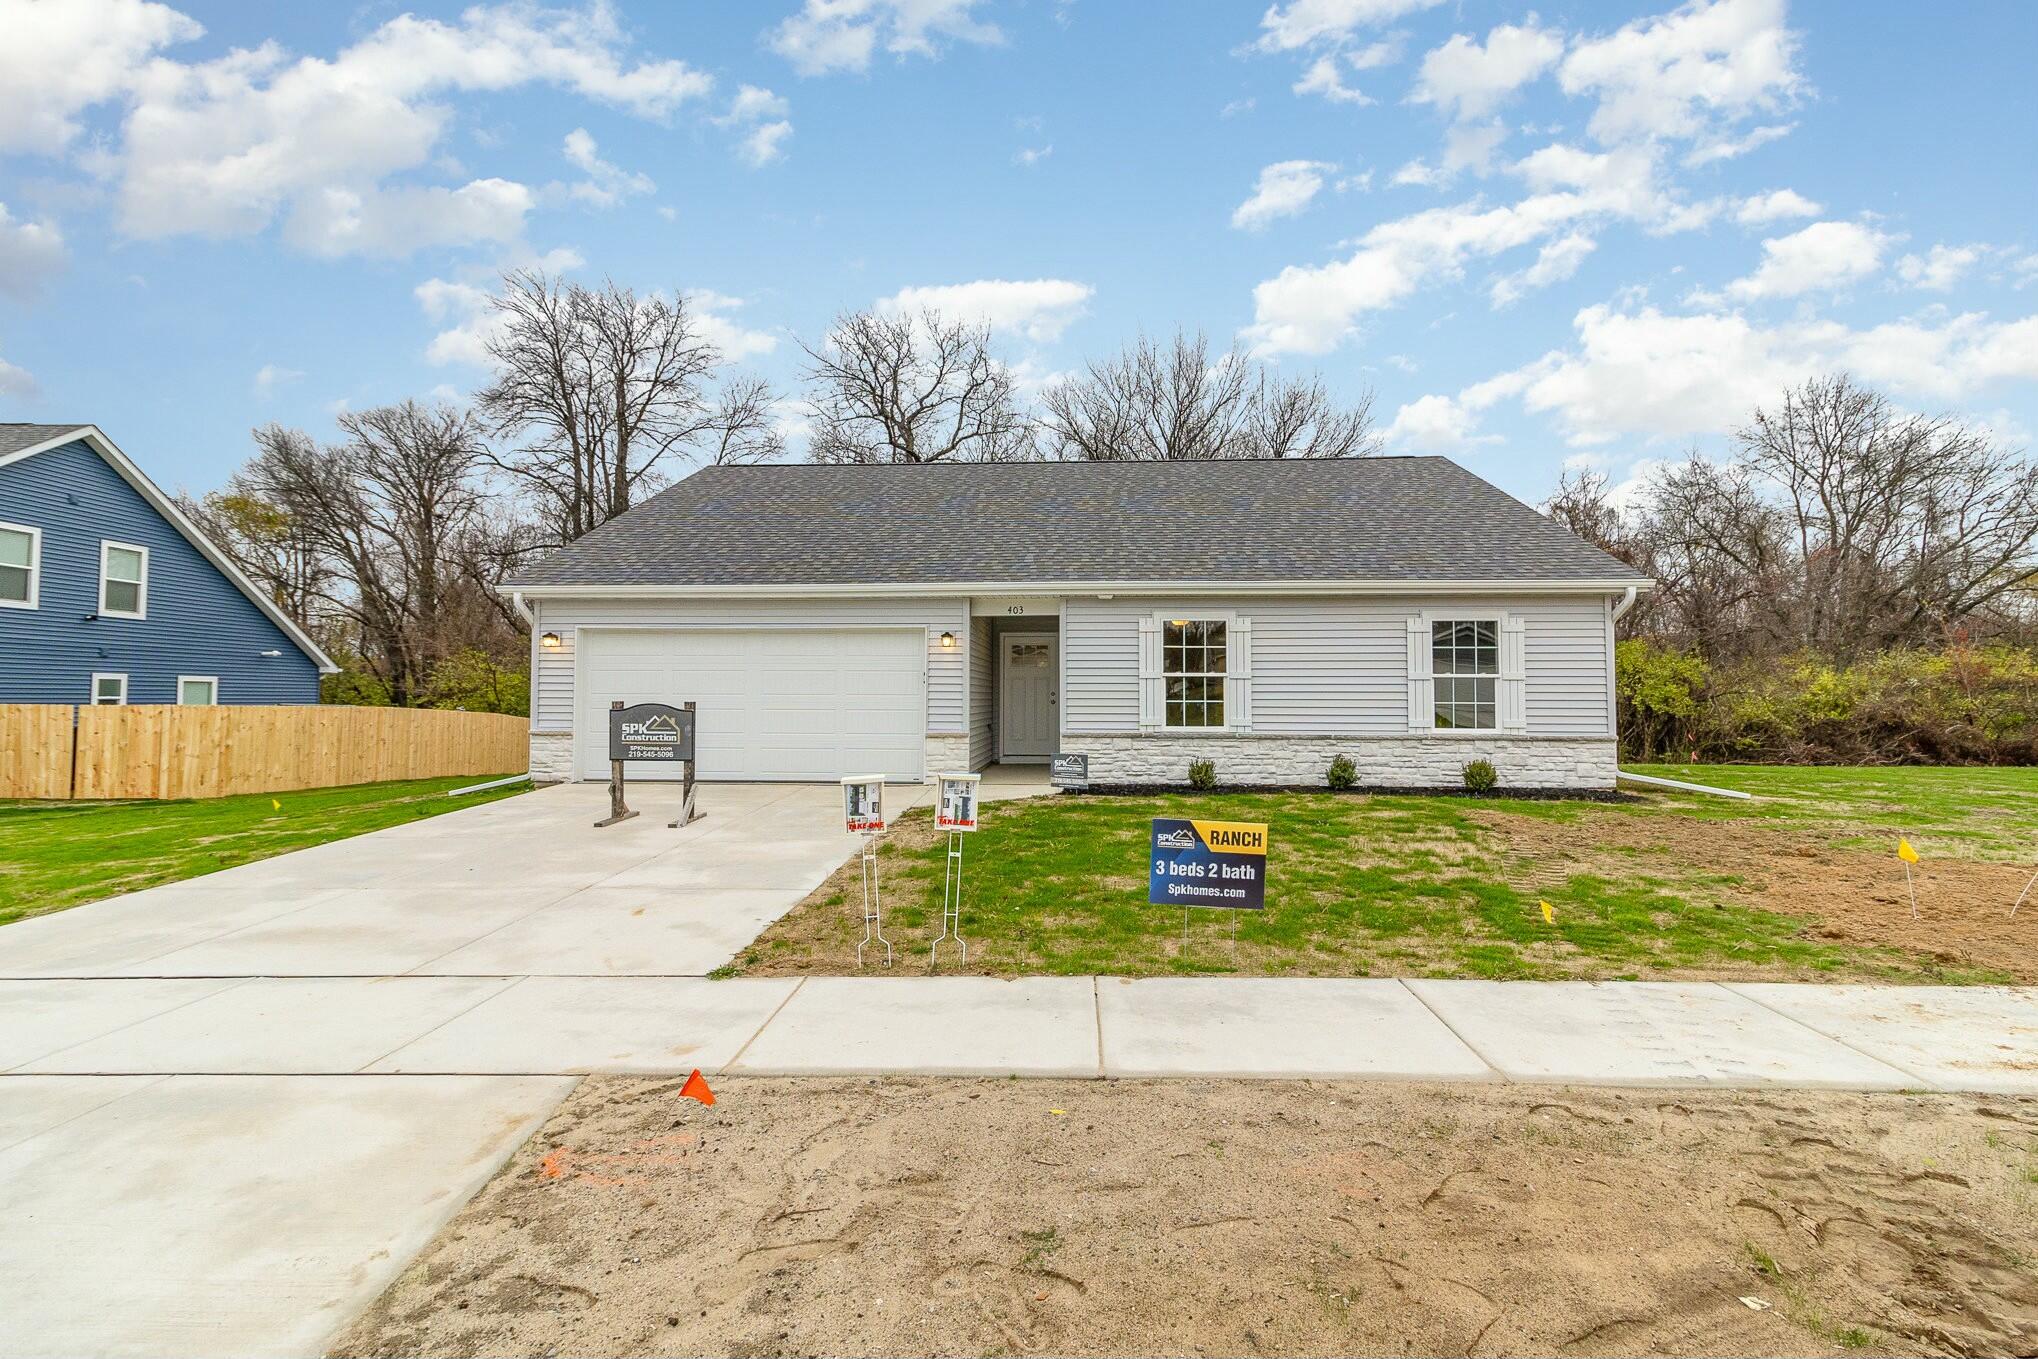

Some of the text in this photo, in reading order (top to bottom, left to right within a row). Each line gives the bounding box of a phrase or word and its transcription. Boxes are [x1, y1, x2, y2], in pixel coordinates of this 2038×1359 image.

[1007, 605, 1024, 615] 403
[621, 723, 648, 734] SPK
[621, 733, 677, 742] Construction
[848, 821, 885, 830] TAKE ONE
[1157, 840, 1193, 848] Construction
[1209, 830, 1262, 848] RANCH
[1155, 860, 1256, 880] 3 beds 2 bath
[1168, 883, 1246, 898] Spkhomes.com
